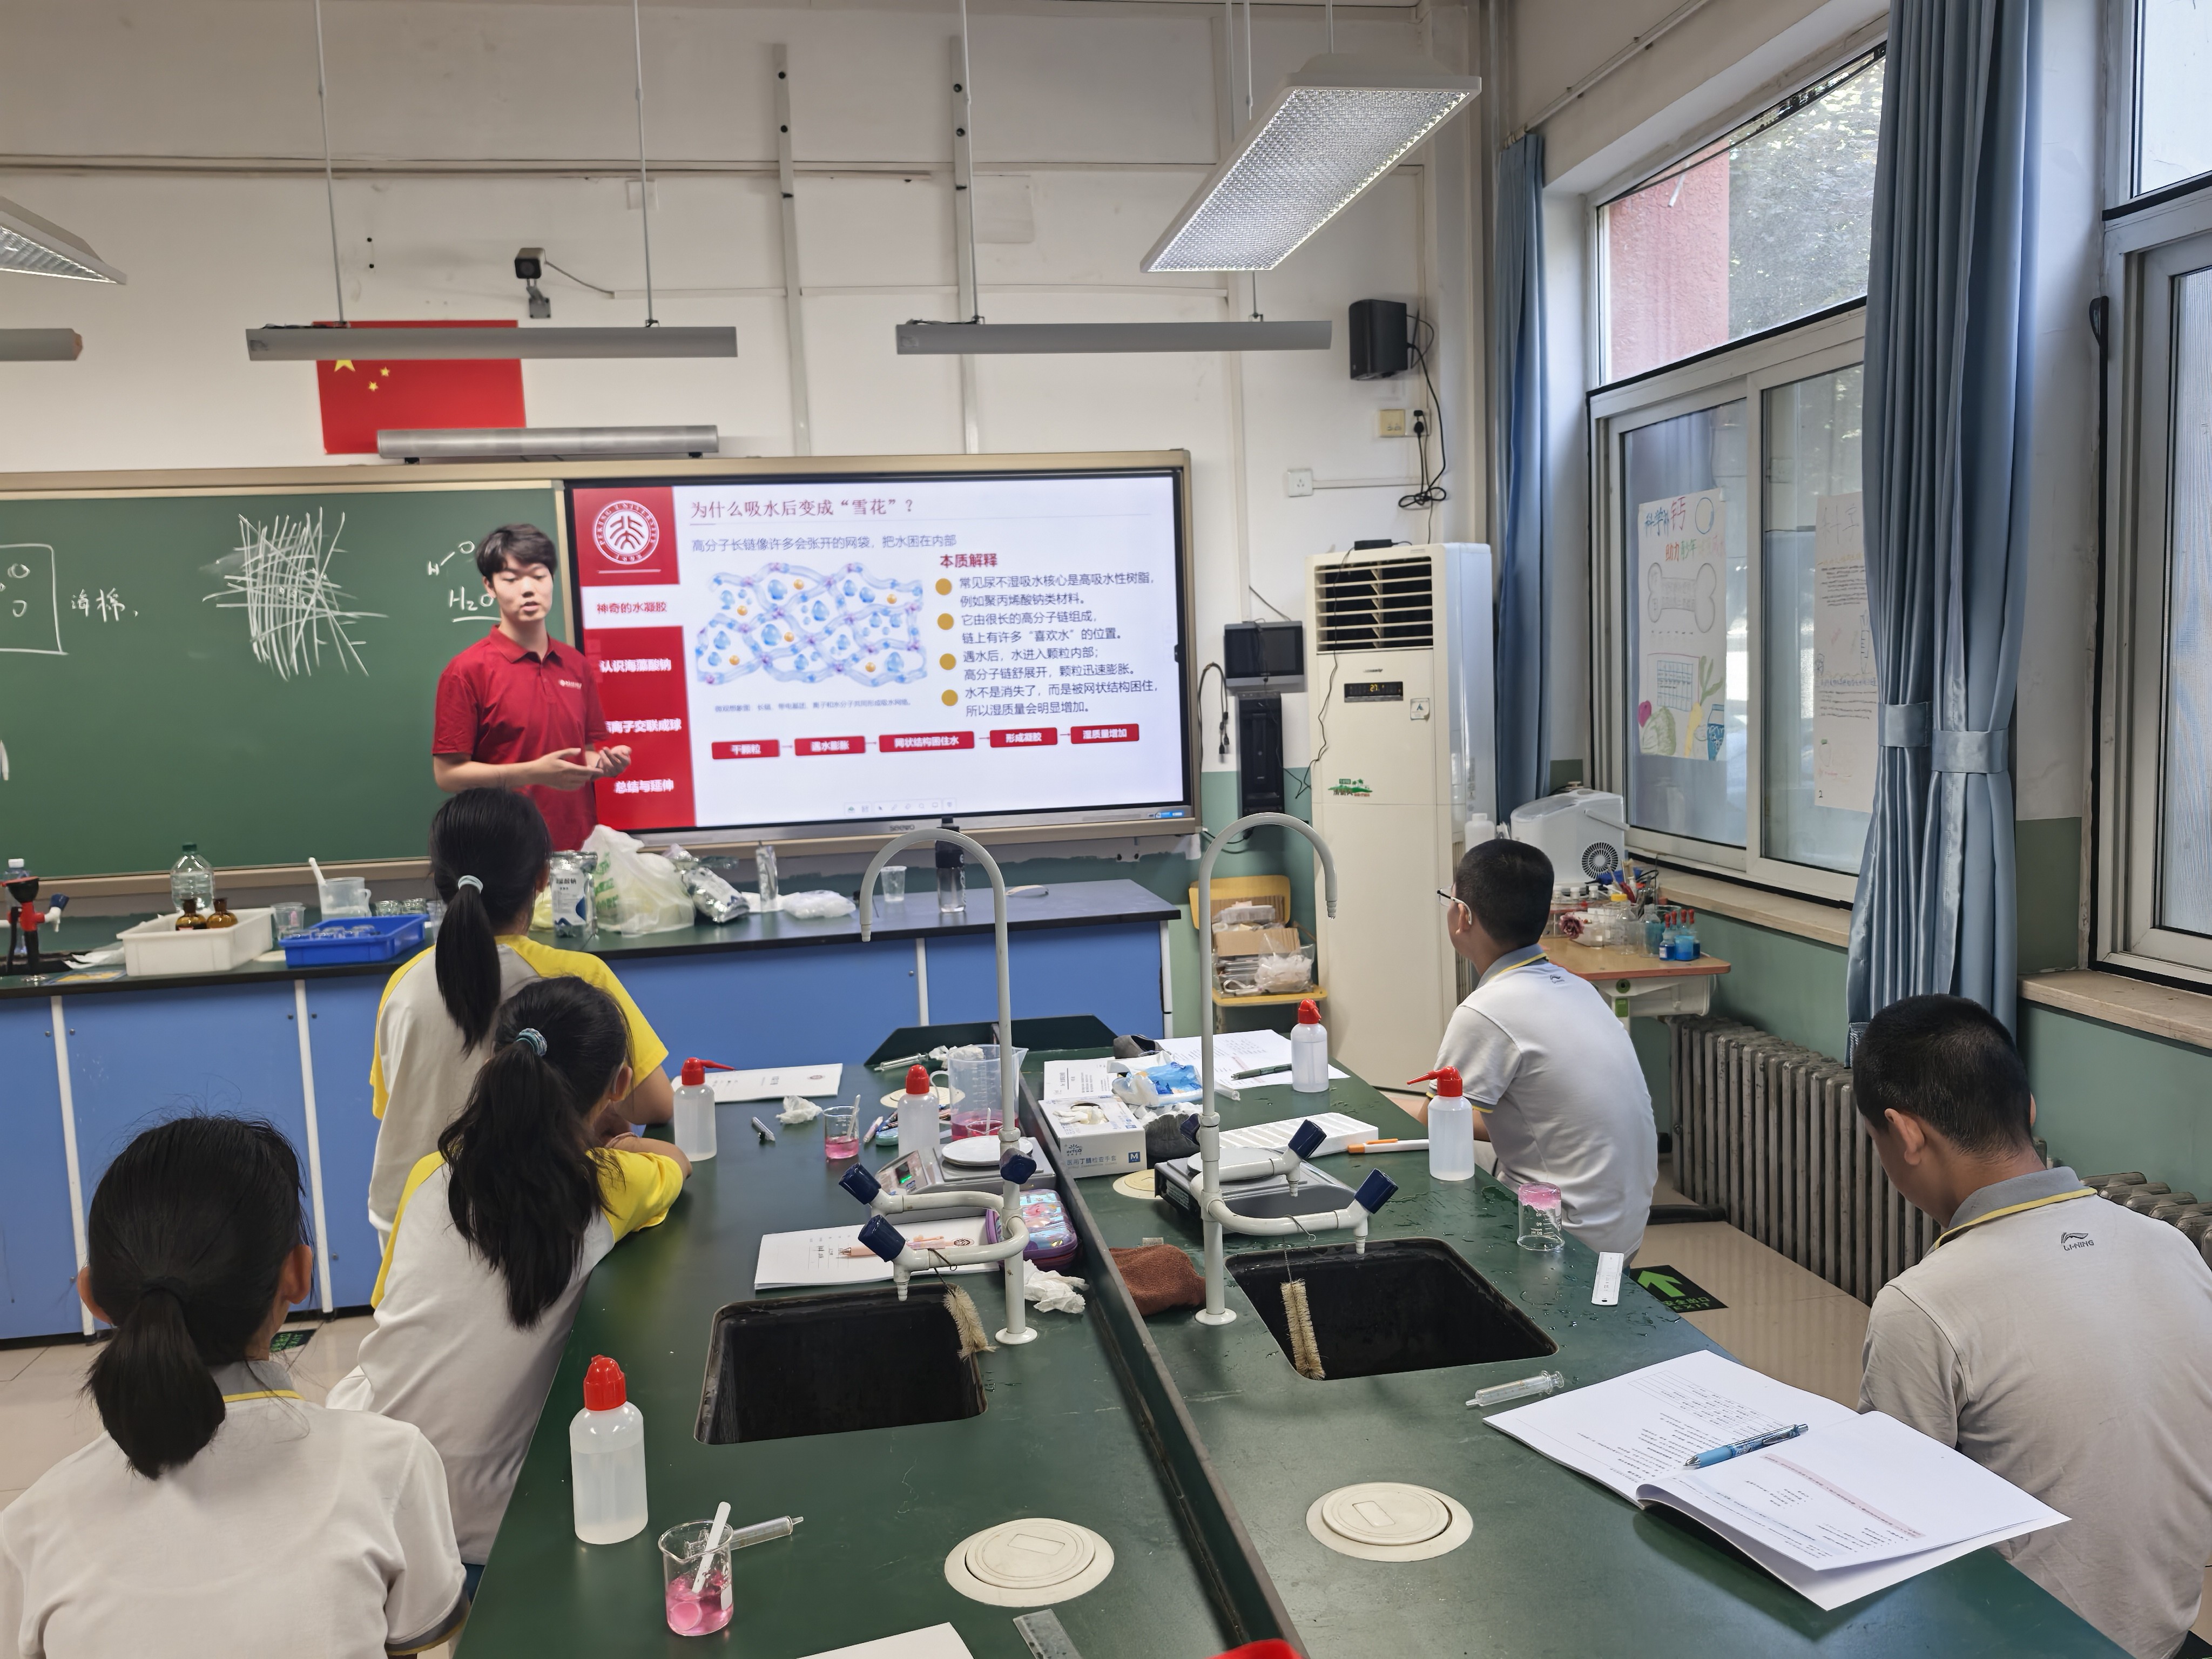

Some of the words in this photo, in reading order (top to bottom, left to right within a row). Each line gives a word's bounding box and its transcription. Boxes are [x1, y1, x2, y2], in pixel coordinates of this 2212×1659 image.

[691, 498, 914, 518] 为什么吸水后变成“雪花”？
[692, 535, 956, 552] 高分子长链像许多会张开的网袋，把水困在内部
[940, 552, 998, 569] 本质解释
[960, 572, 1154, 589] 常见尿不湿吸水核心是高吸水性树脂，
[960, 592, 1084, 608] 例如聚丙烯酸钠类材料。
[596, 602, 667, 615] 神奇的水凝胶
[962, 610, 1097, 626] 它由很长的高分子链组成，
[962, 628, 1122, 644] 链上有许多“喜欢水”的位置。
[963, 647, 1098, 663] 遇水后，水进入颗粒内部；
[599, 658, 672, 673] 认识海藻酸钠
[964, 664, 1135, 680] 高分子链舒展开，颗粒迅速膨胀。
[965, 680, 1158, 699] 水不是消失了，而是被网状结构困住，
[966, 701, 1089, 717] 所以湿质量会明显增加。
[1005, 732, 1043, 743] 形成凝胶
[1082, 728, 1127, 739] 湿质量增加
[730, 744, 761, 756] 干颗粒
[811, 740, 850, 752] 遇水膨胀
[894, 736, 960, 748] 网状结构困住水
[614, 779, 674, 794] 总结与延伸
[2063, 1240, 2094, 1251] LI-NING
